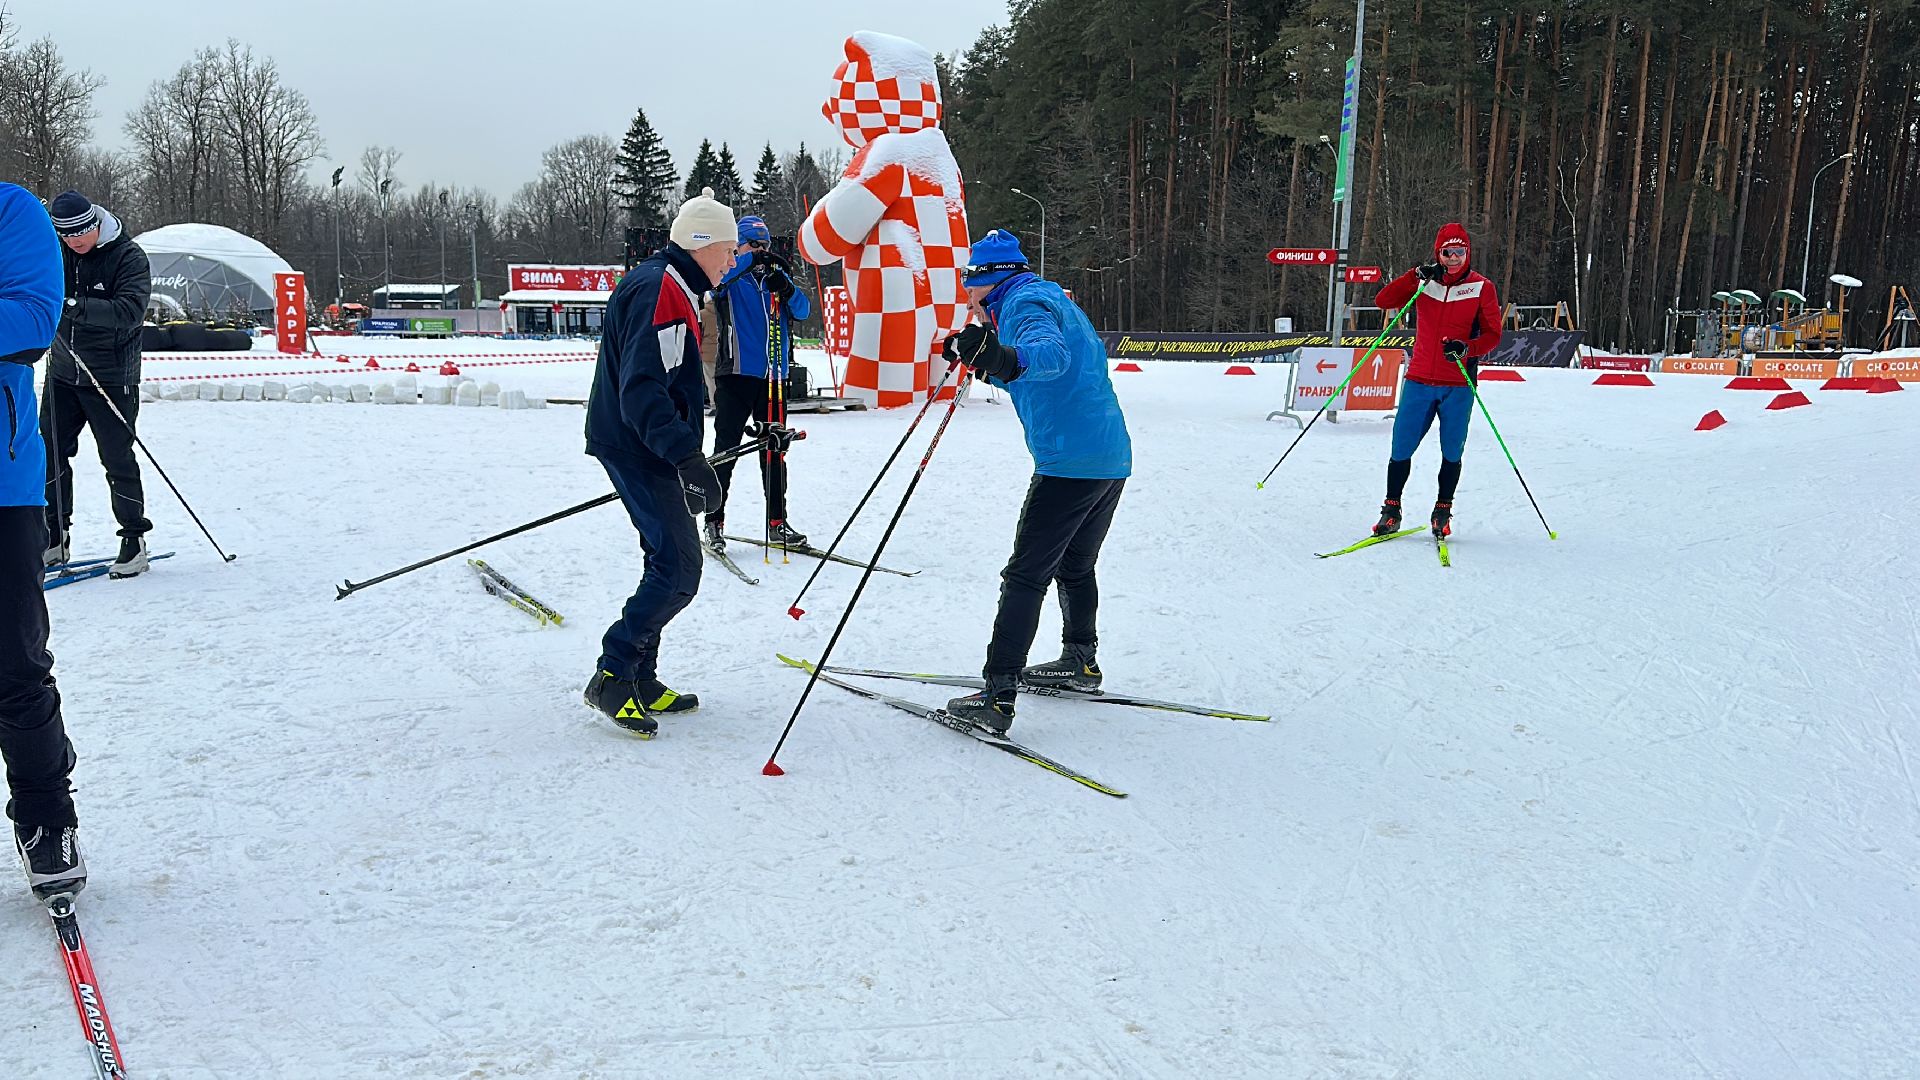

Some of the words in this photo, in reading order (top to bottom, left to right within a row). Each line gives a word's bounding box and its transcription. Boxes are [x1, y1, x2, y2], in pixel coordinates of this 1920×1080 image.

[1276, 252, 1314, 261] ФИНИШ
[521, 272, 565, 284] ЗИМА
[285, 277, 298, 344] СТАРТ
[838, 291, 849, 348] ФИНИШ
[1117, 336, 1157, 356] Привет
[1152, 341, 1223, 356] участникам
[1673, 362, 1725, 371] CHOCOLATE
[1765, 362, 1823, 372] CHOCOLATE
[1867, 361, 1920, 372] CHOCOLA
[1352, 385, 1393, 397] ФИНИШ
[1029, 669, 1075, 678] SALOMON
[1017, 685, 1061, 698] CHER
[78, 983, 119, 1074] MADSHUS
